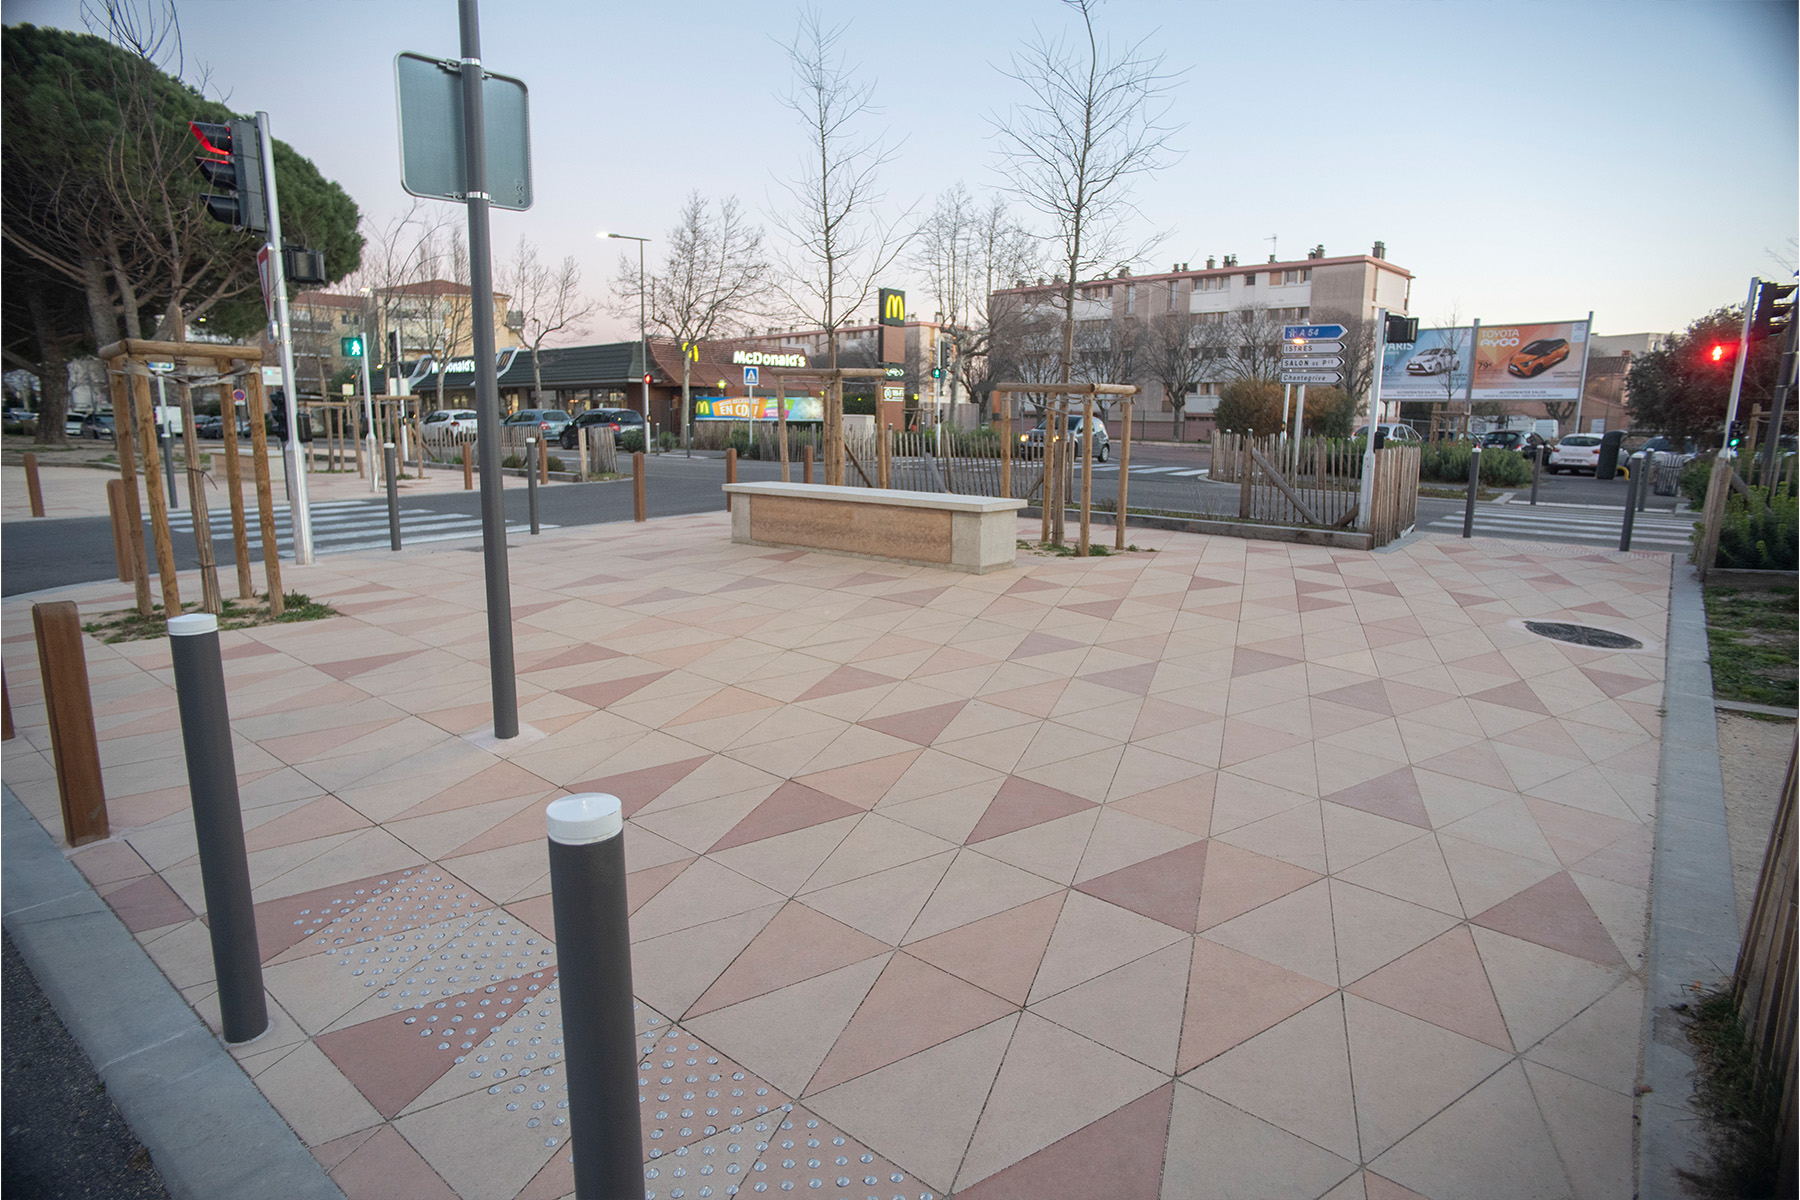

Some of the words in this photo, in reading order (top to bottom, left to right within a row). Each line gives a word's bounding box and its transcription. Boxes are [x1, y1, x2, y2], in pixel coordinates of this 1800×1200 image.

[1308, 328, 1319, 336] 54
[1481, 329, 1519, 338] TOYOTA
[1480, 337, 1519, 347] AYGO
[733, 351, 806, 367] McDonald's
[432, 360, 475, 374] Monald's
[720, 404, 733, 415] EN
